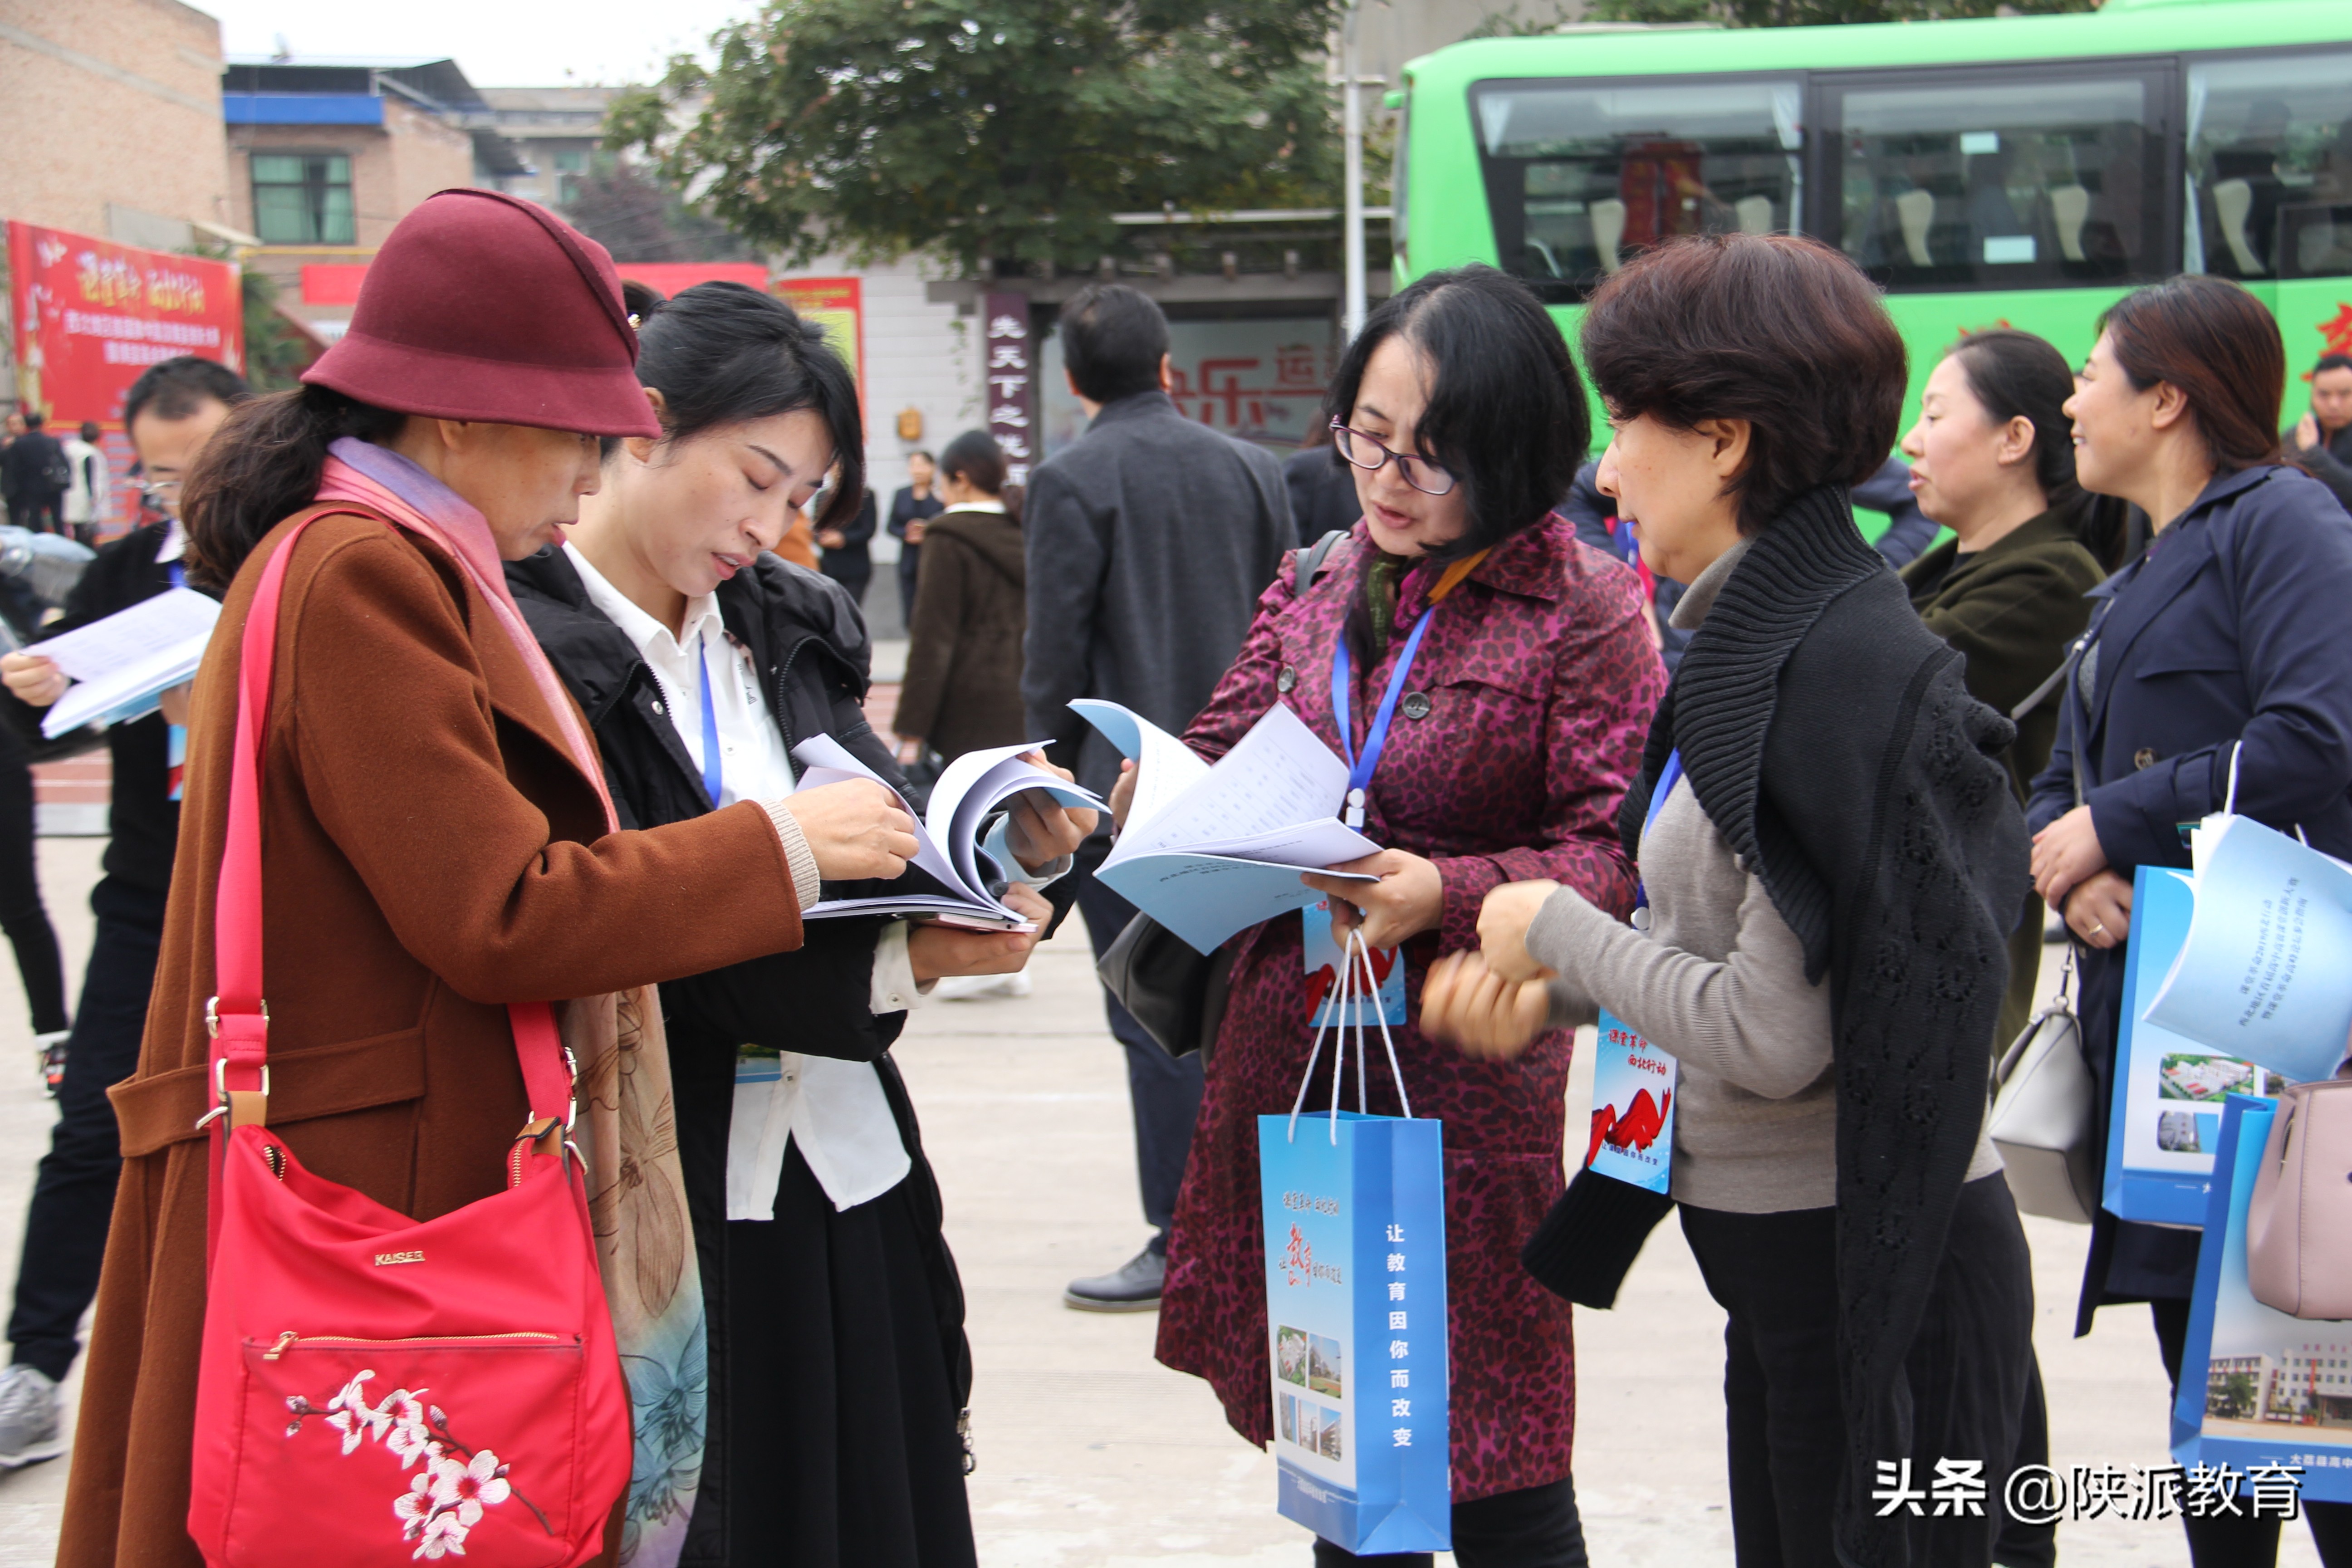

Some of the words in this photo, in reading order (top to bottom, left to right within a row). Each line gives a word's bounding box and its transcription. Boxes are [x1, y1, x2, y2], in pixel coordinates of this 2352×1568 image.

[1609, 1029, 1648, 1053] 课堂革命
[1627, 1054, 1666, 1076] 西北行动
[1386, 1224, 1412, 1447] 让教育因你而改变
